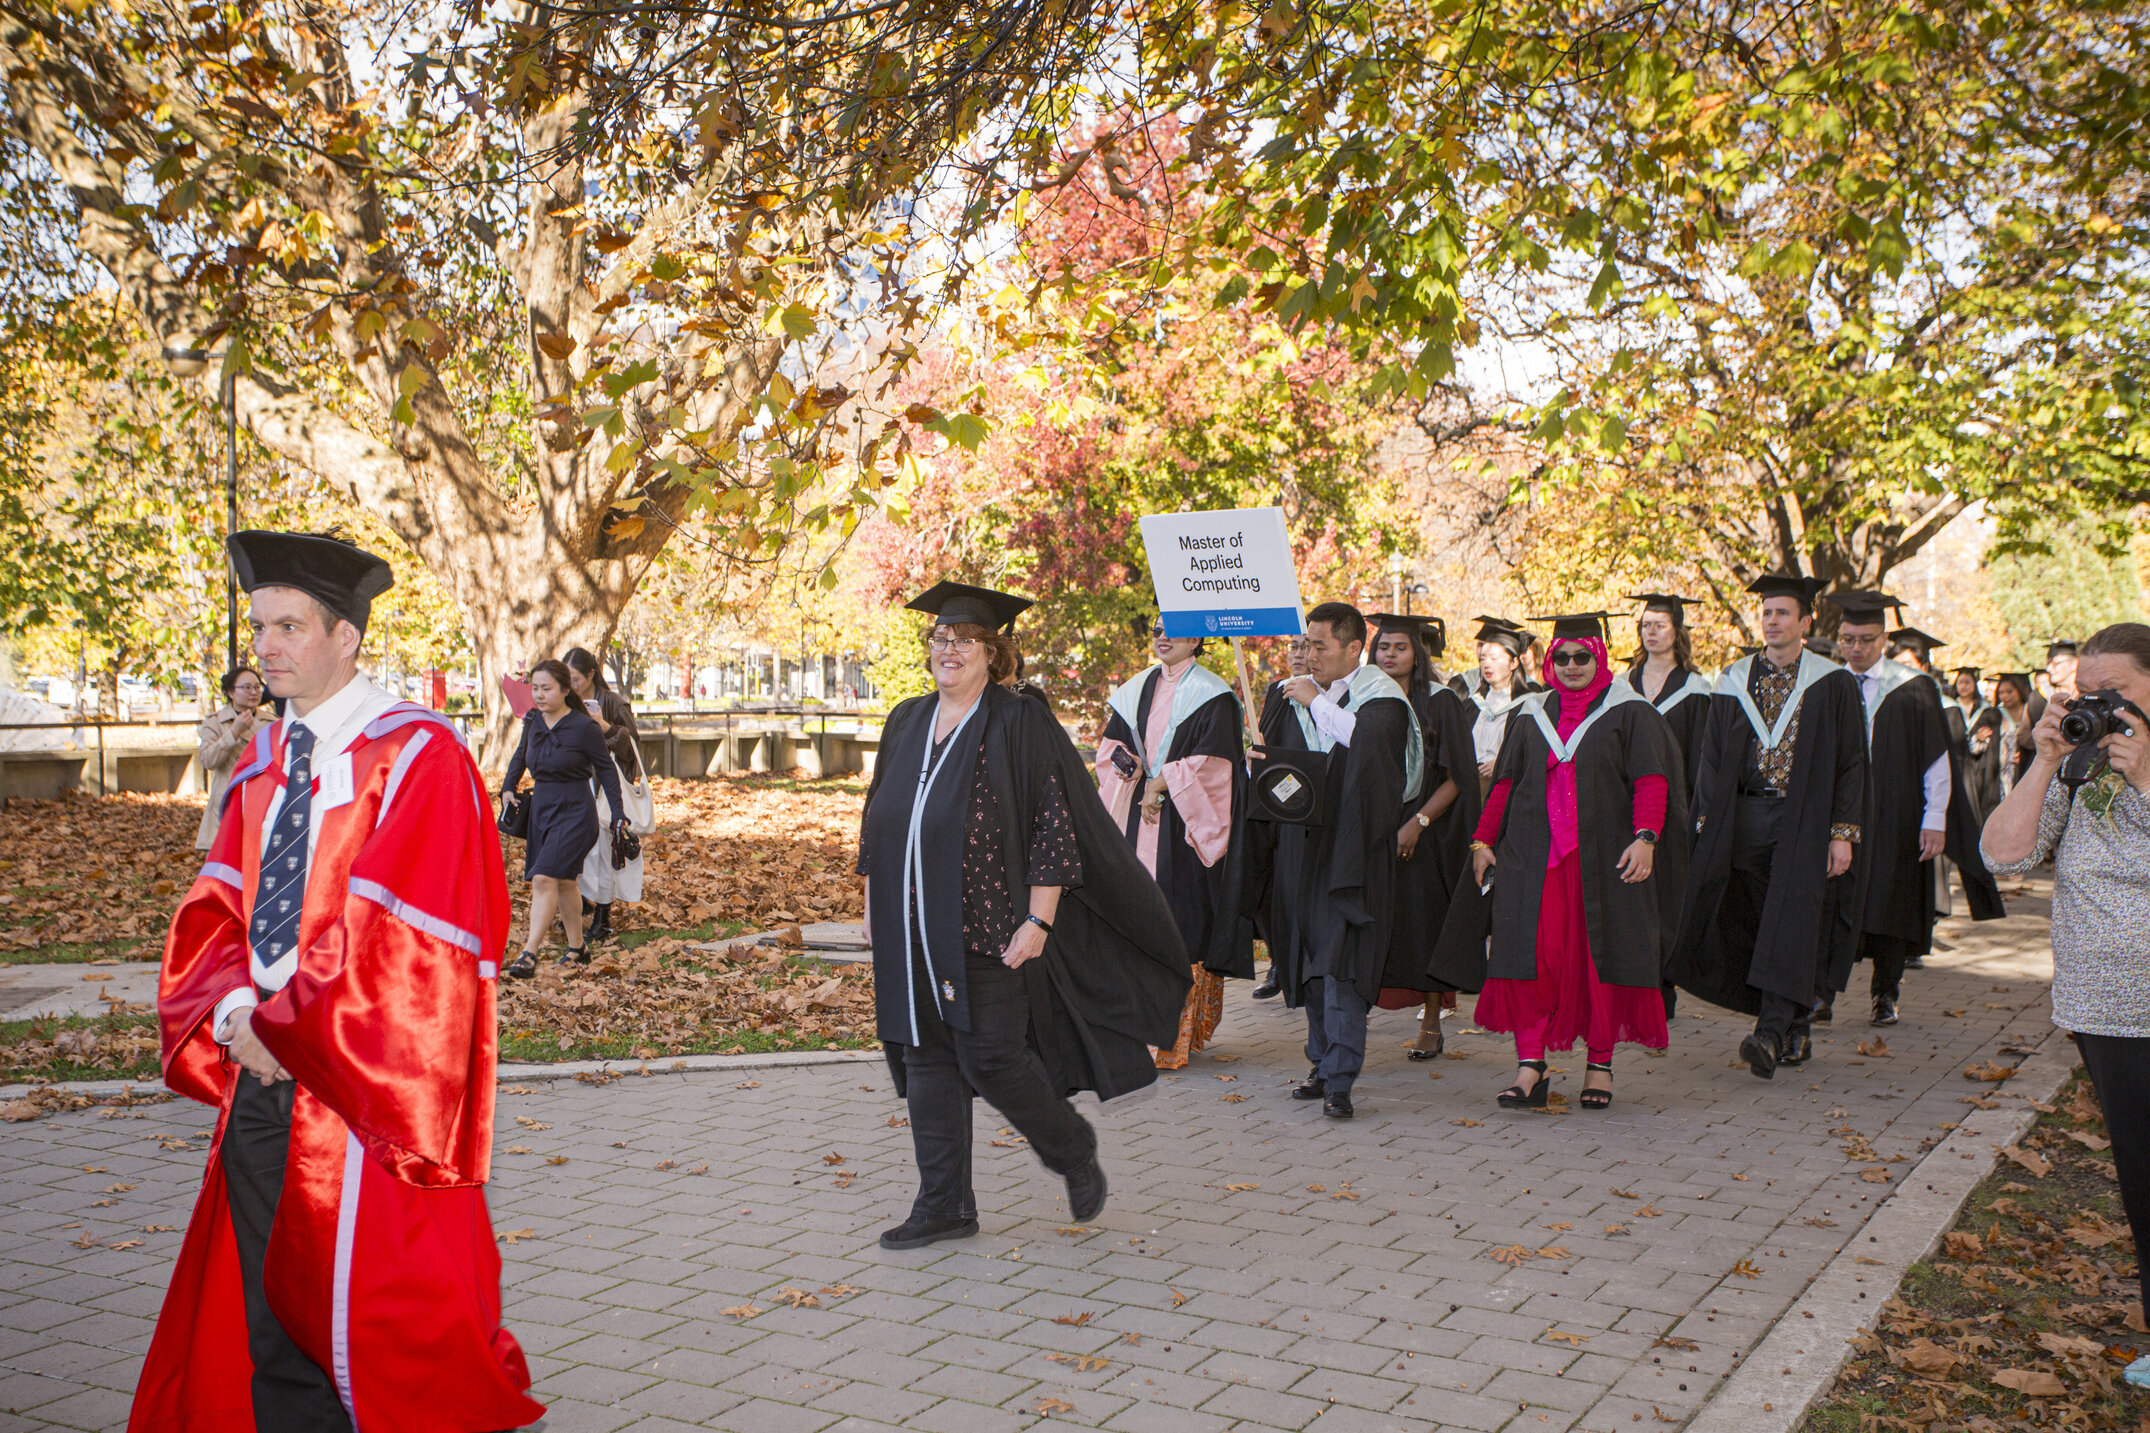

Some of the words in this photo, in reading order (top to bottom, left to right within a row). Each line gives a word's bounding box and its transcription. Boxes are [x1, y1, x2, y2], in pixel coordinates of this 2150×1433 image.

[1178, 536, 1225, 550] Master
[1229, 531, 1243, 548] of
[1190, 553, 1243, 573] Applied
[1182, 575, 1260, 594] Computing
